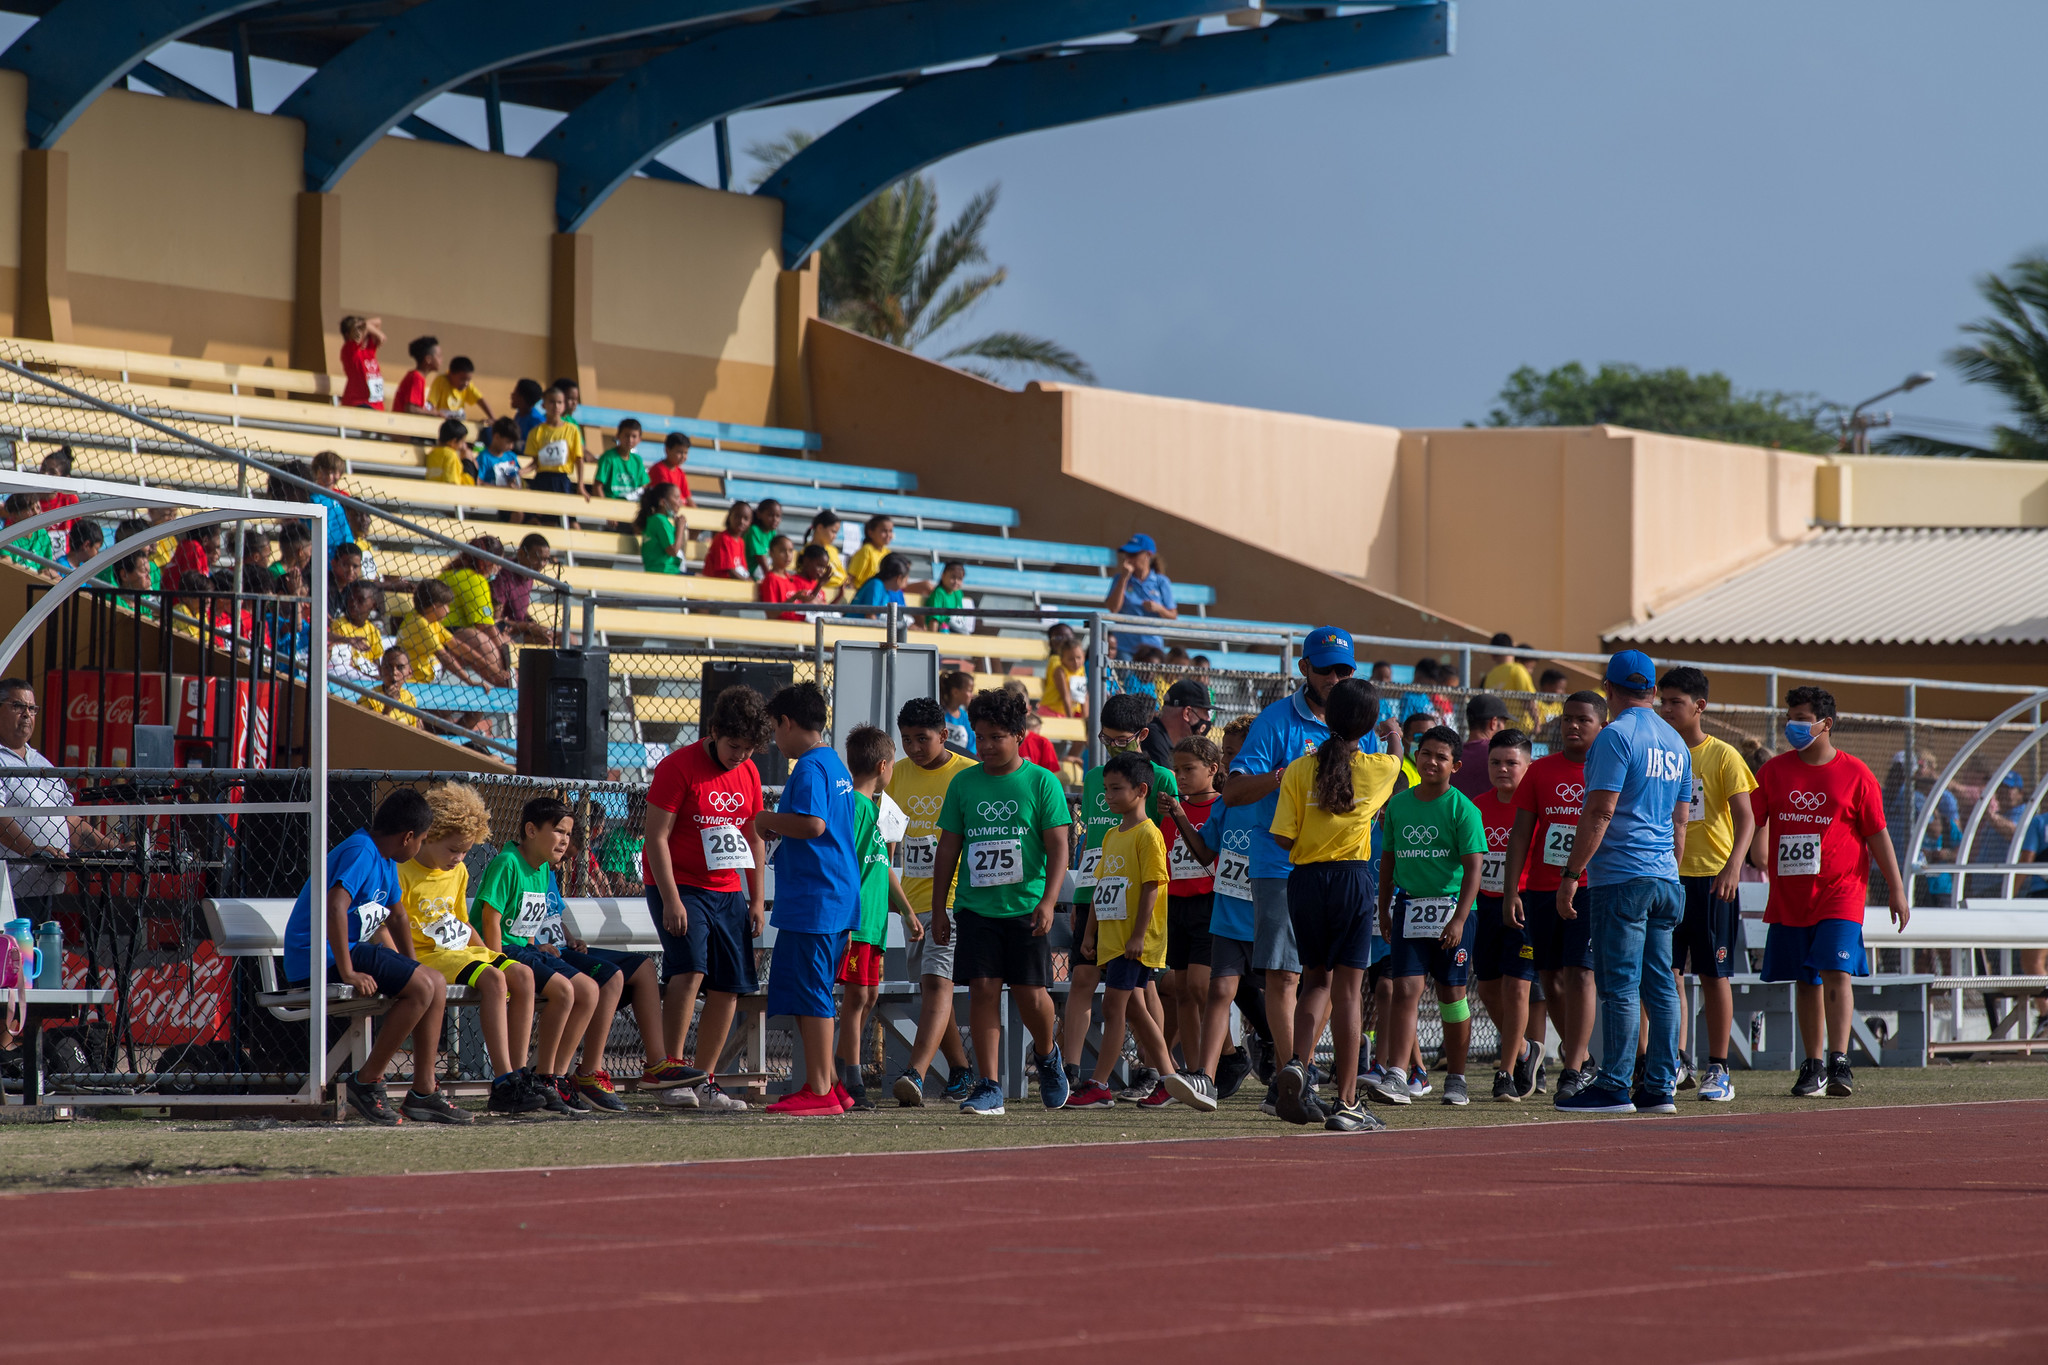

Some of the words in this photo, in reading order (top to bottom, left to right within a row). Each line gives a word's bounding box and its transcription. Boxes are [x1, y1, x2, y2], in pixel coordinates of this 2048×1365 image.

[546, 446, 559, 456] 91
[1545, 806, 1582, 815] OLYMPIC
[1779, 812, 1813, 822] OLYMPIC
[1815, 816, 1833, 825] DAY
[693, 814, 733, 826] OLYMPIC
[968, 826, 1008, 837] OLYMPIC
[1012, 827, 1030, 836] DAY
[708, 833, 747, 854] 285
[1550, 832, 1576, 852] 28
[907, 844, 934, 863] 273
[974, 849, 1014, 871] 275
[1397, 849, 1430, 858] OLYMPIC
[1432, 849, 1451, 857] DAY
[1780, 842, 1815, 861] 268
[1482, 860, 1505, 878] 27
[1095, 885, 1120, 904] 267
[522, 901, 545, 922] 292
[1411, 905, 1450, 923] 287
[435, 917, 467, 944] 232
